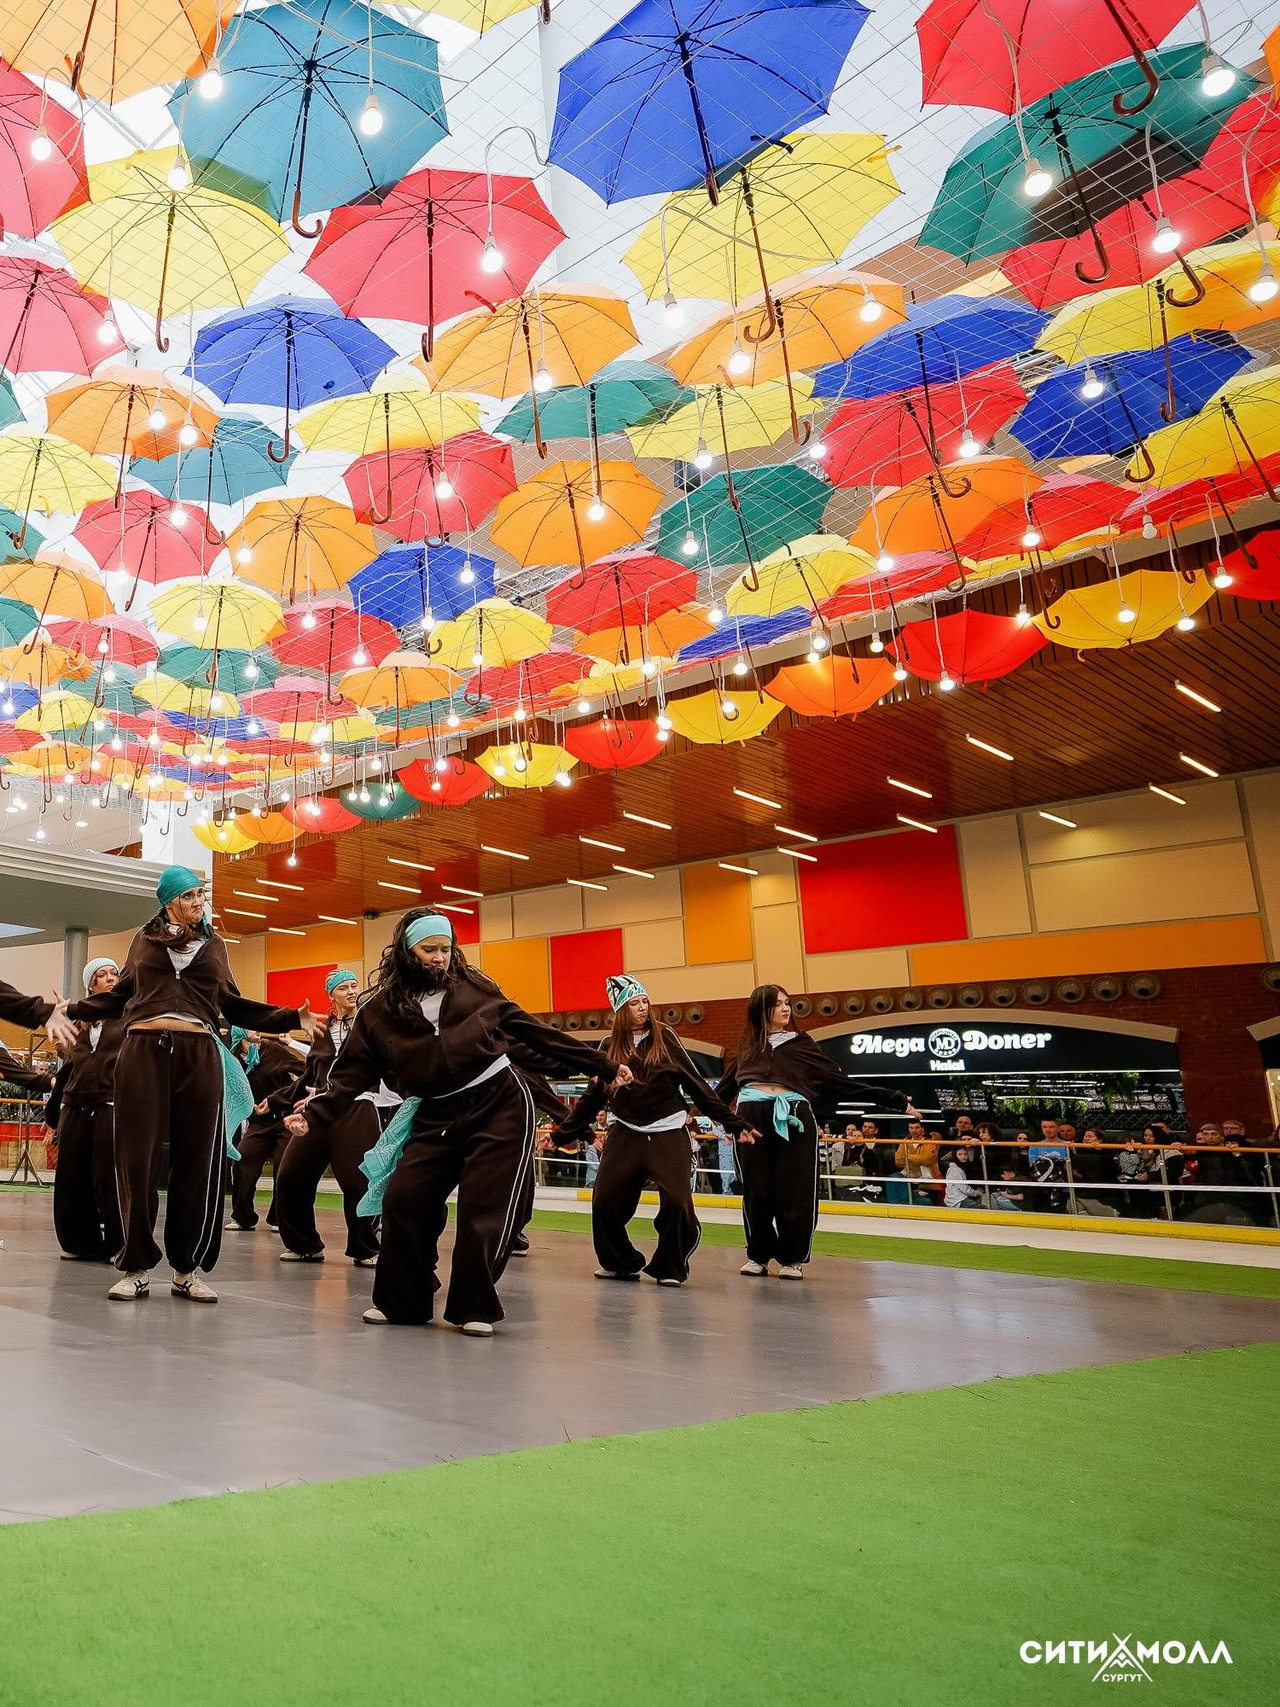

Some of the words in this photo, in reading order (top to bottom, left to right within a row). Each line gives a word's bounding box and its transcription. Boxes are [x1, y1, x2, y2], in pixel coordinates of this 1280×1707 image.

[850, 1034, 925, 1057] Mega
[962, 1030, 1052, 1051] Doner
[930, 1059, 966, 1071] Halal
